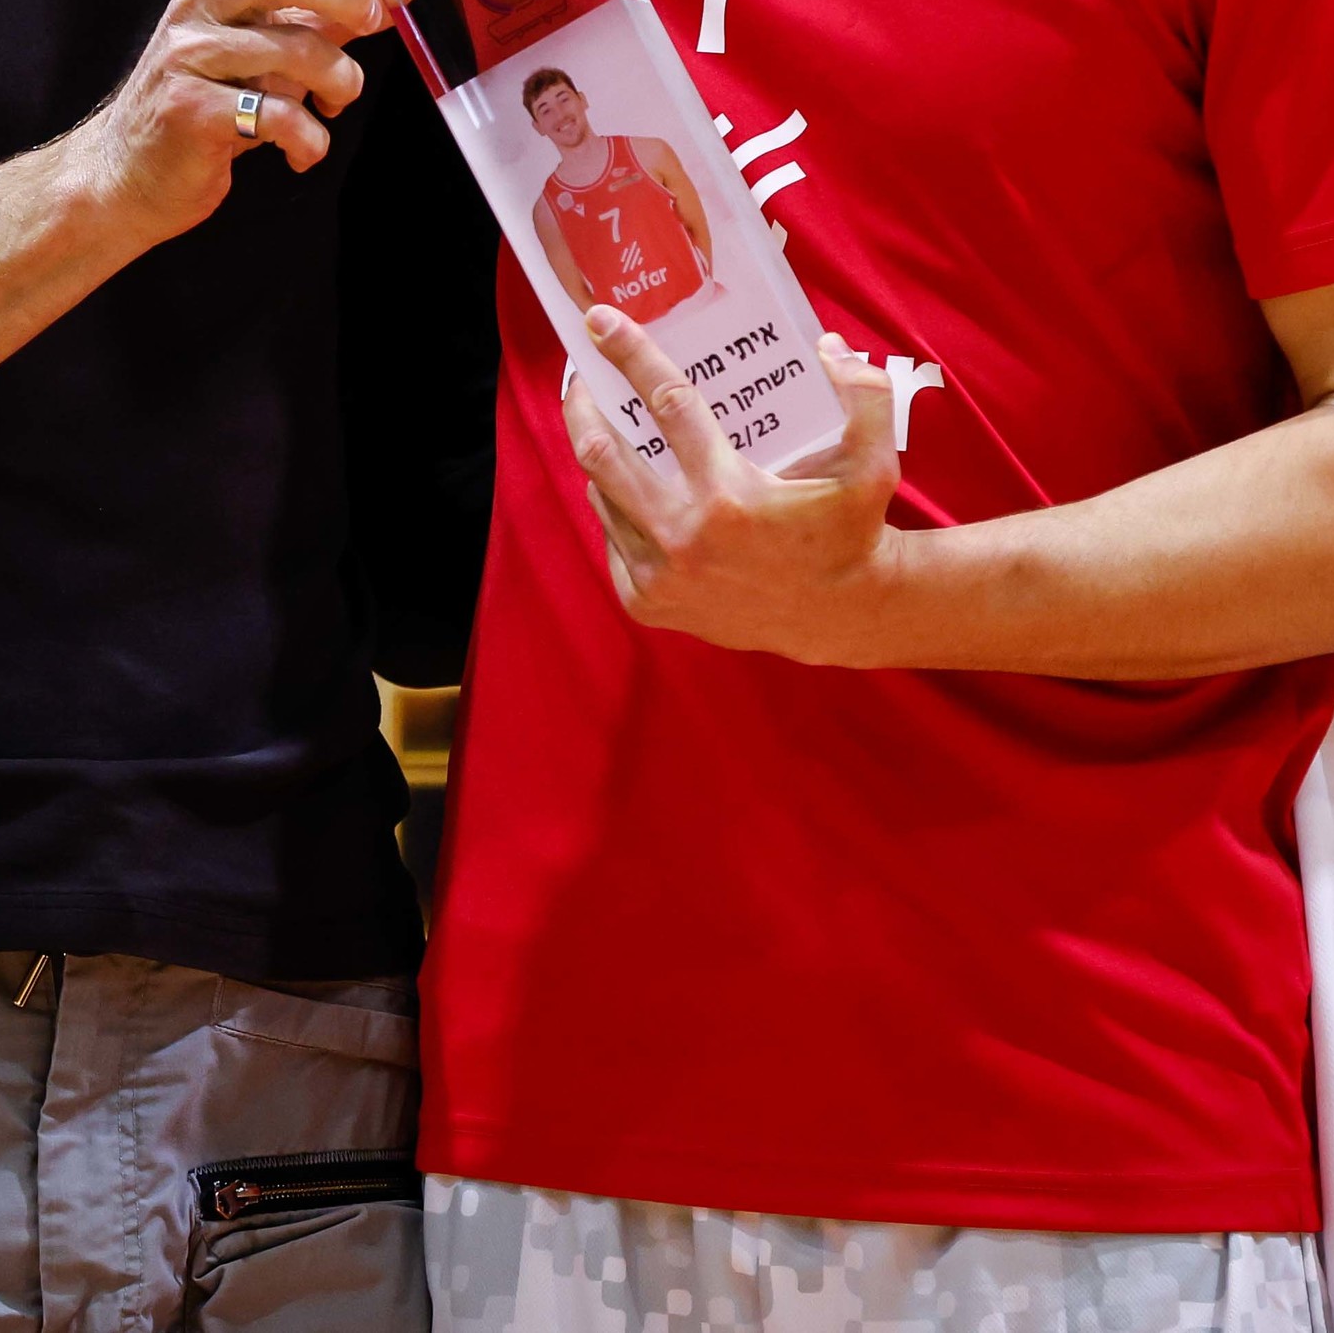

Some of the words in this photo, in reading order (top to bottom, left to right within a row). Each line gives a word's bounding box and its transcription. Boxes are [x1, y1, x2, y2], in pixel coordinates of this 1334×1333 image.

[598, 207, 622, 243] 7
[611, 266, 668, 304] Nofar
[724, 321, 780, 361] איתי
